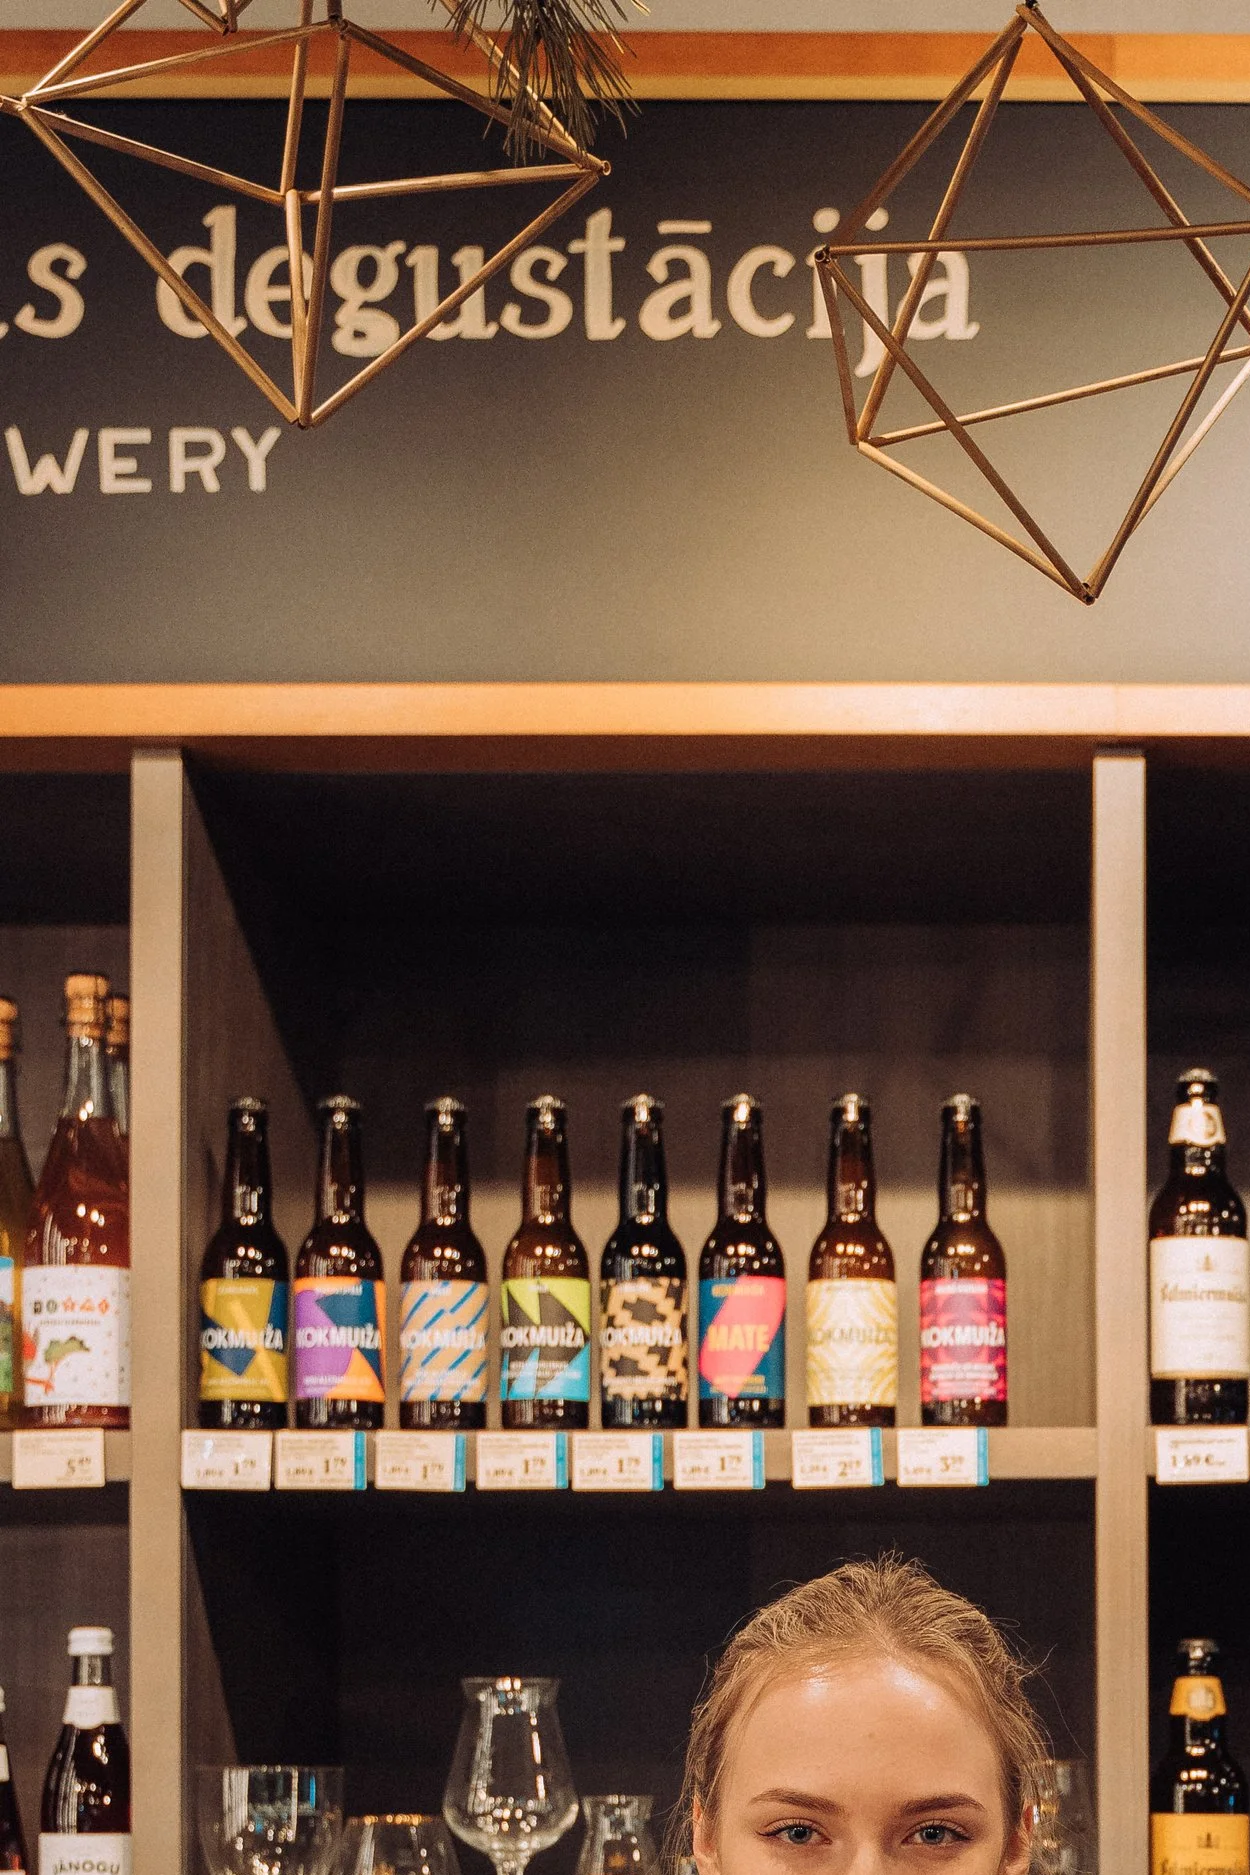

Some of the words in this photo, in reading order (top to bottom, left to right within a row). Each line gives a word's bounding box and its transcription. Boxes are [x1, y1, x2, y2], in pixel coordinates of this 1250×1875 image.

[153, 204, 979, 380] degustācija
[4, 425, 283, 495] WERY
[707, 1323, 770, 1352] MATE
